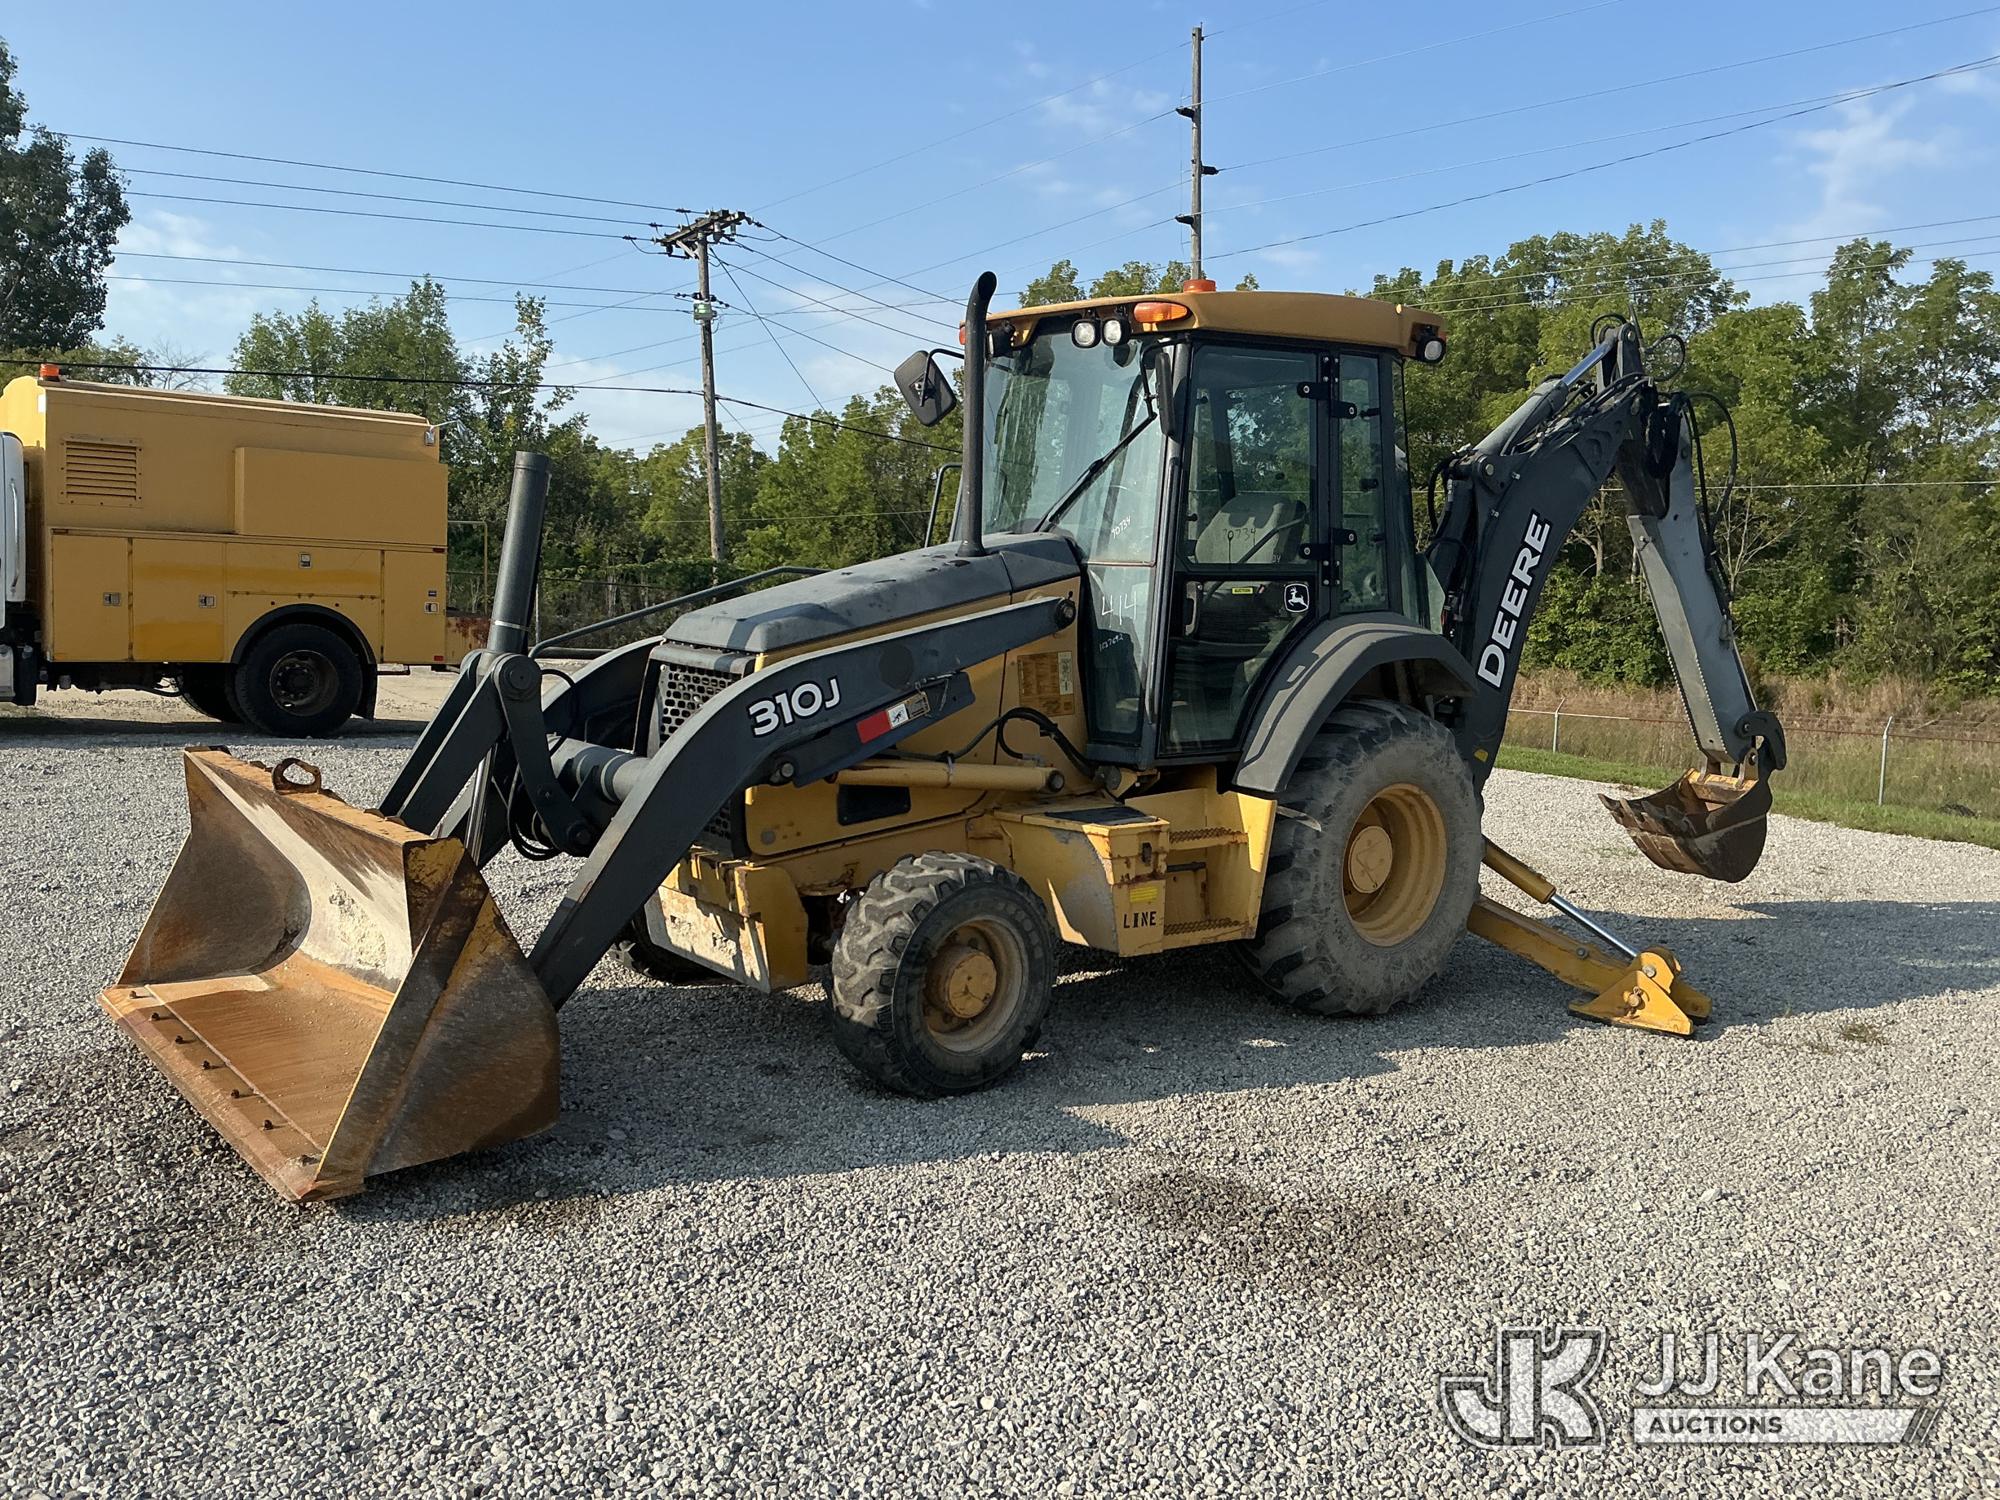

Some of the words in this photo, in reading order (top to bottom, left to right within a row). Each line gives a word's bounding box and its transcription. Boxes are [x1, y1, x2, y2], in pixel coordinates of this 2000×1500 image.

[1102, 591, 1137, 627] 414
[1478, 513, 1551, 688] DEERE
[749, 678, 841, 736] 310J
[1123, 911, 1157, 929] LINE
